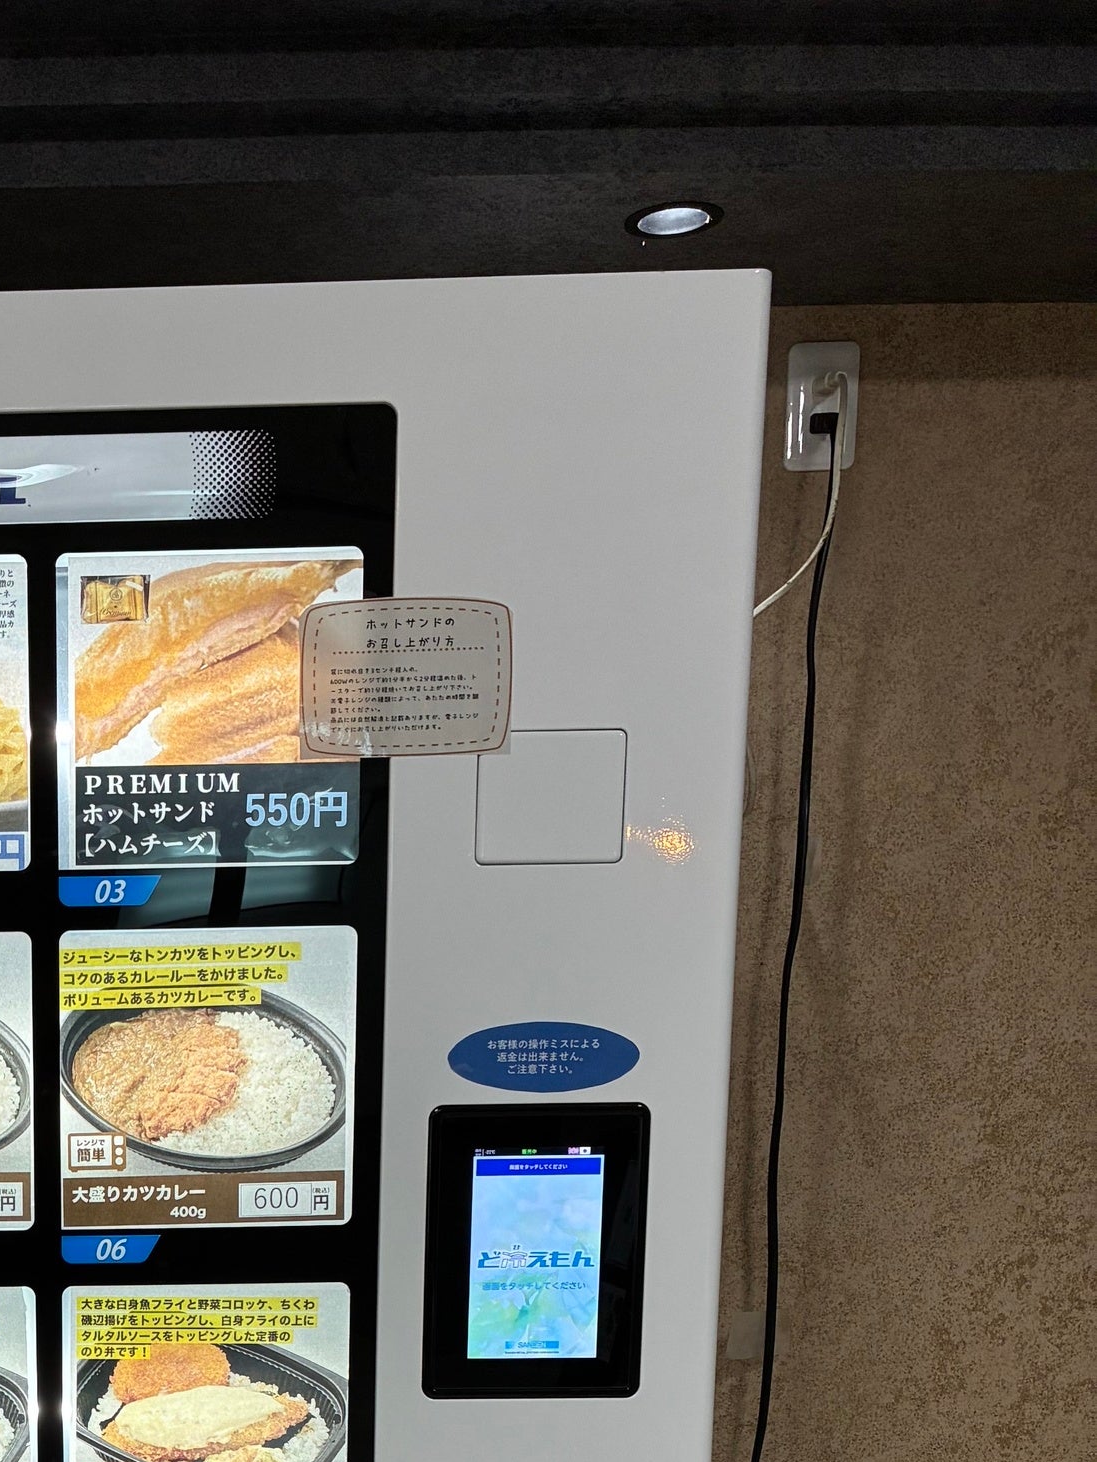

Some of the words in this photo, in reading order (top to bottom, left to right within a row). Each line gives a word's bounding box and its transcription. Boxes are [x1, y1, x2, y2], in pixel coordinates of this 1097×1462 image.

[366, 617, 455, 630] ホットサンドの
[366, 636, 455, 649] お召し上がり方
[84, 773, 241, 795] PREMIUM
[82, 801, 215, 825] ホットサンド
[245, 791, 349, 828] 550円
[85, 831, 221, 858] 【ハムチーズ】
[94, 879, 127, 904] 03
[62, 945, 298, 965] ジューシーなトンカツをトッピングし、
[63, 967, 285, 985] コクのあるカレールーをかけました。
[63, 990, 258, 1007] ボリュームあるカツカレーです。
[487, 1039, 600, 1050] お客様の操作ミスによる
[497, 1052, 584, 1063] 返金は出来ません。
[507, 1064, 573, 1075] ご注意下さい。
[76, 1138, 105, 1146] レンジで
[77, 1148, 106, 1162] 簡単
[71, 1186, 206, 1203] 大盛りカツカレー
[255, 1187, 300, 1209] 600
[313, 1195, 329, 1211] 円
[0, 1195, 16, 1212] 円
[170, 1207, 207, 1220] 400g
[96, 1238, 127, 1261] 06
[478, 1251, 594, 1268] ど冷えもん
[81, 1330, 291, 1342] タルタルソースをトッピングした定番の
